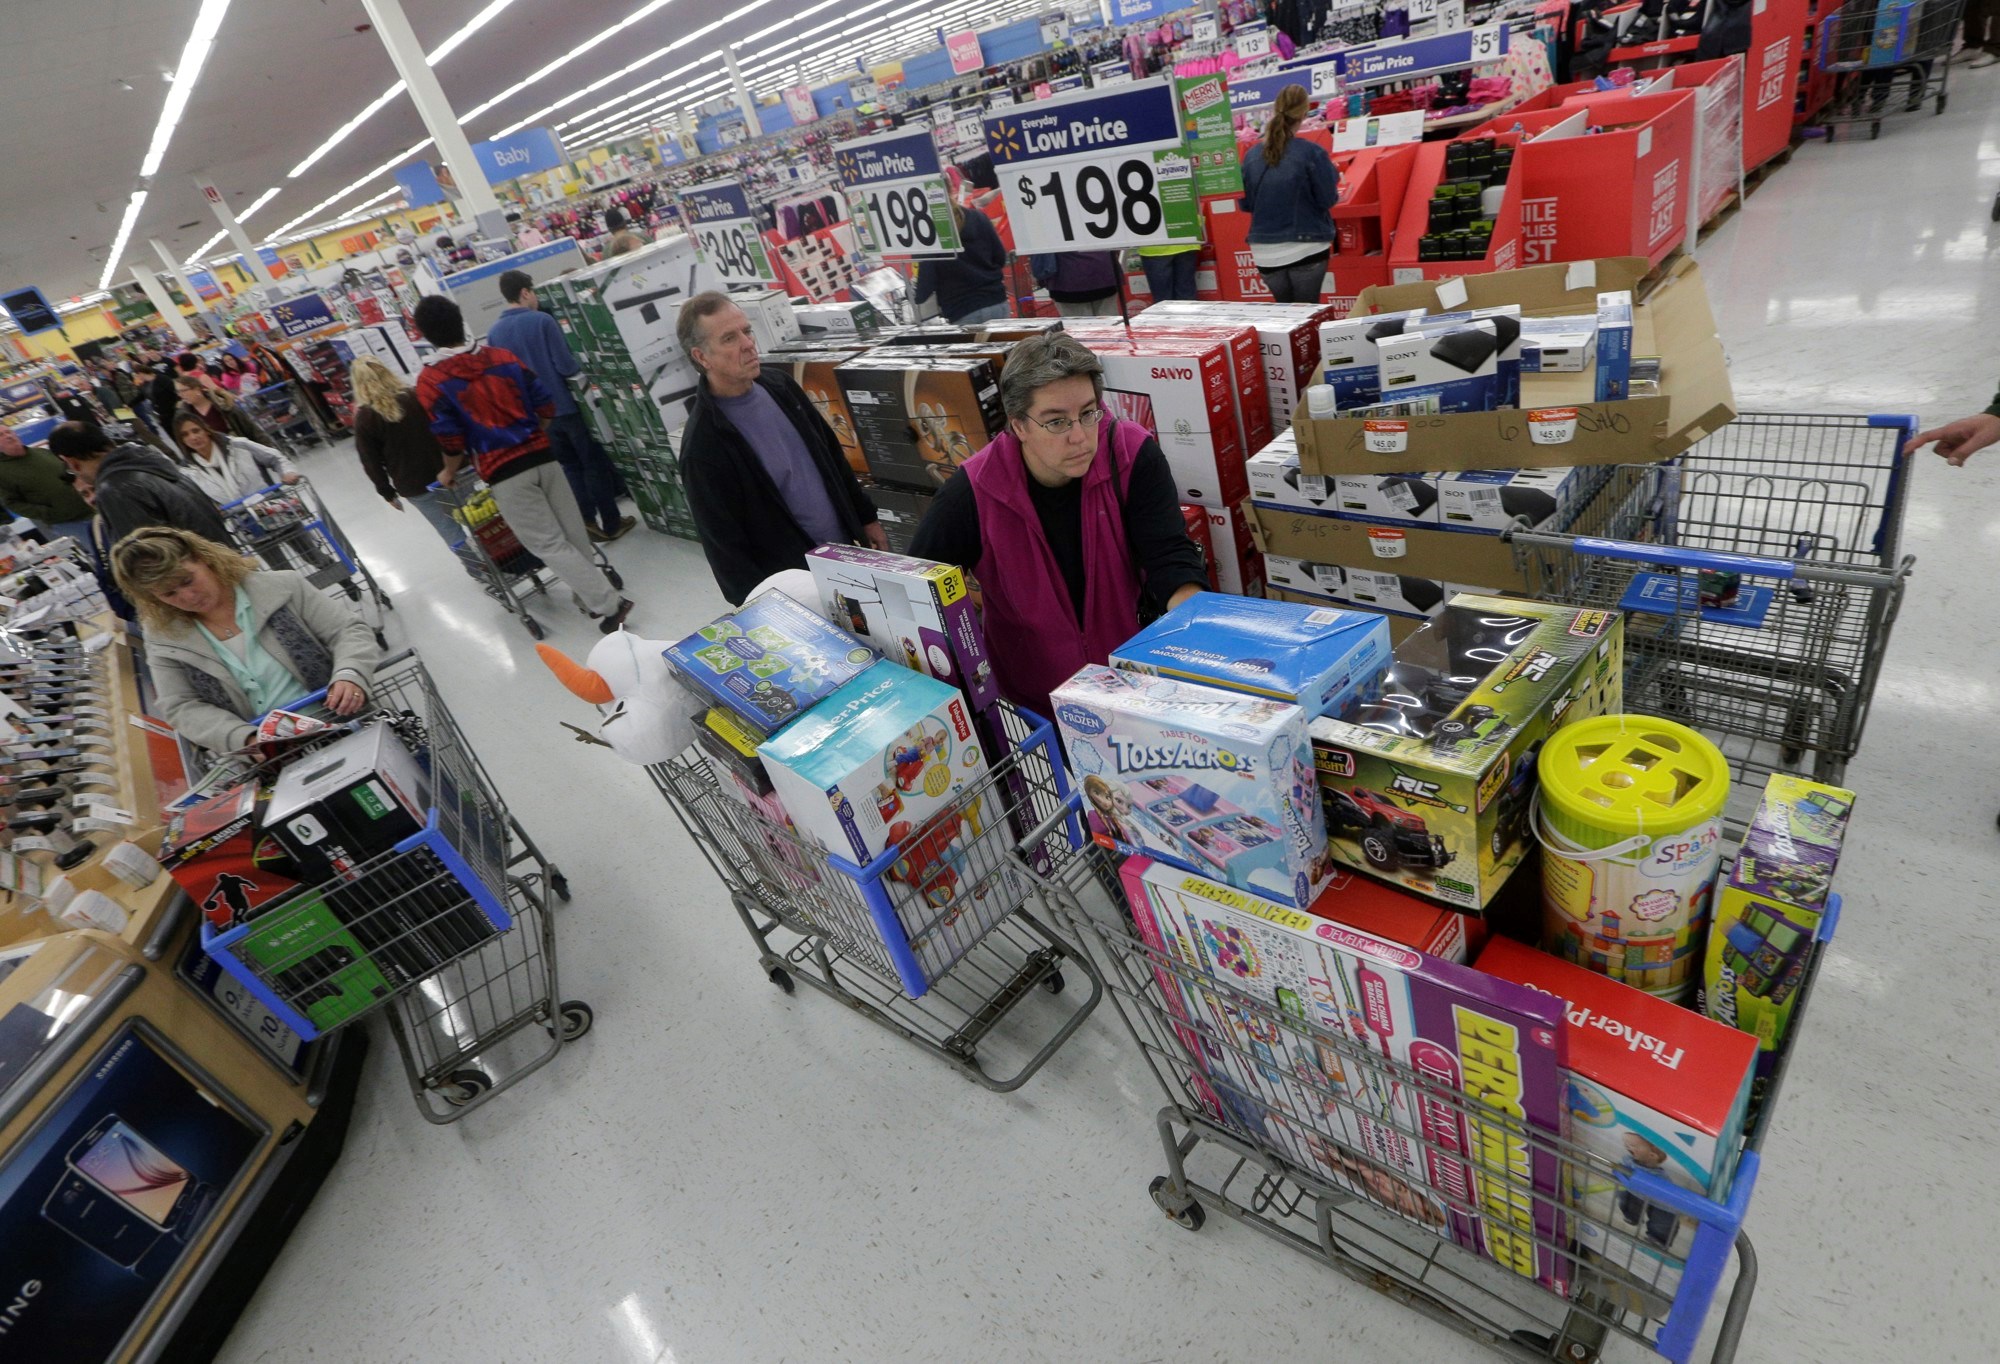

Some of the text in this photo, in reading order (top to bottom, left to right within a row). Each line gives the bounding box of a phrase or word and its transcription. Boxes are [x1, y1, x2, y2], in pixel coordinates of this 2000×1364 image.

[1364, 54, 1414, 74] Low Price
[1763, 42, 1789, 68] WHILE
[1761, 60, 1787, 83] SUPPLIES
[1184, 80, 1218, 102] MERRY
[1238, 90, 1261, 102] Price
[1758, 73, 1785, 105] LAST
[1188, 91, 1222, 110] CHRISTMAS
[1021, 115, 1058, 130] Everyday
[1022, 116, 1128, 154] Low Price
[493, 146, 530, 167] Baby
[858, 152, 915, 179] Low Price
[1156, 163, 1189, 177] Layaway
[1653, 163, 1678, 197] WHILE
[696, 202, 714, 219] Low
[714, 198, 735, 217] Price
[1019, 158, 1162, 243] $198
[1651, 185, 1677, 214] SUPPLIES
[867, 186, 937, 248] 198
[1521, 201, 1557, 223] ILE
[1649, 201, 1673, 239] LAST
[699, 228, 757, 278] $348
[1523, 238, 1557, 262] ST
[1237, 268, 1259, 279] SUPP
[828, 317, 849, 328] VIZIO
[1236, 337, 1253, 351] SANYO
[1259, 342, 1282, 356] ZIO
[1326, 334, 1356, 344] SONY
[1205, 354, 1222, 368] SANYO
[1386, 350, 1419, 362] SONY
[1151, 367, 1193, 381] SANYO
[1539, 428, 1567, 438] $45.00
[1373, 439, 1397, 448] $45.00
[1251, 471, 1275, 479] SONY
[1340, 480, 1368, 489] SONY
[1269, 557, 1291, 566] SONY
[942, 577, 957, 600] 150
[1351, 574, 1371, 583] SON
[823, 624, 838, 636] THE
[957, 627, 967, 650] INCLUDES
[1233, 660, 1270, 673] vtech
[951, 702, 967, 738] Fisher-Price
[1062, 710, 1099, 728] FROZEN
[1160, 730, 1209, 745] TABLE TOP
[1313, 749, 1328, 760] EW
[1315, 759, 1347, 774] RIGHT
[1394, 774, 1440, 798] RC
[1385, 788, 1448, 808] CHARGERS
[211, 817, 252, 844] BASKETBALL
[1434, 876, 1474, 895] USB
[1180, 876, 1313, 931] PERSONALIZED
[1325, 926, 1407, 963] JEWELRY STUDIO
[224, 990, 241, 1010] 9
[1364, 980, 1378, 1022] BRACELETS
[1372, 980, 1391, 1032] SLIDER CHARM
[259, 1015, 279, 1039] 10
[1539, 1031, 1553, 1045] 6+
[95, 1038, 134, 1080] SAMSUNG
